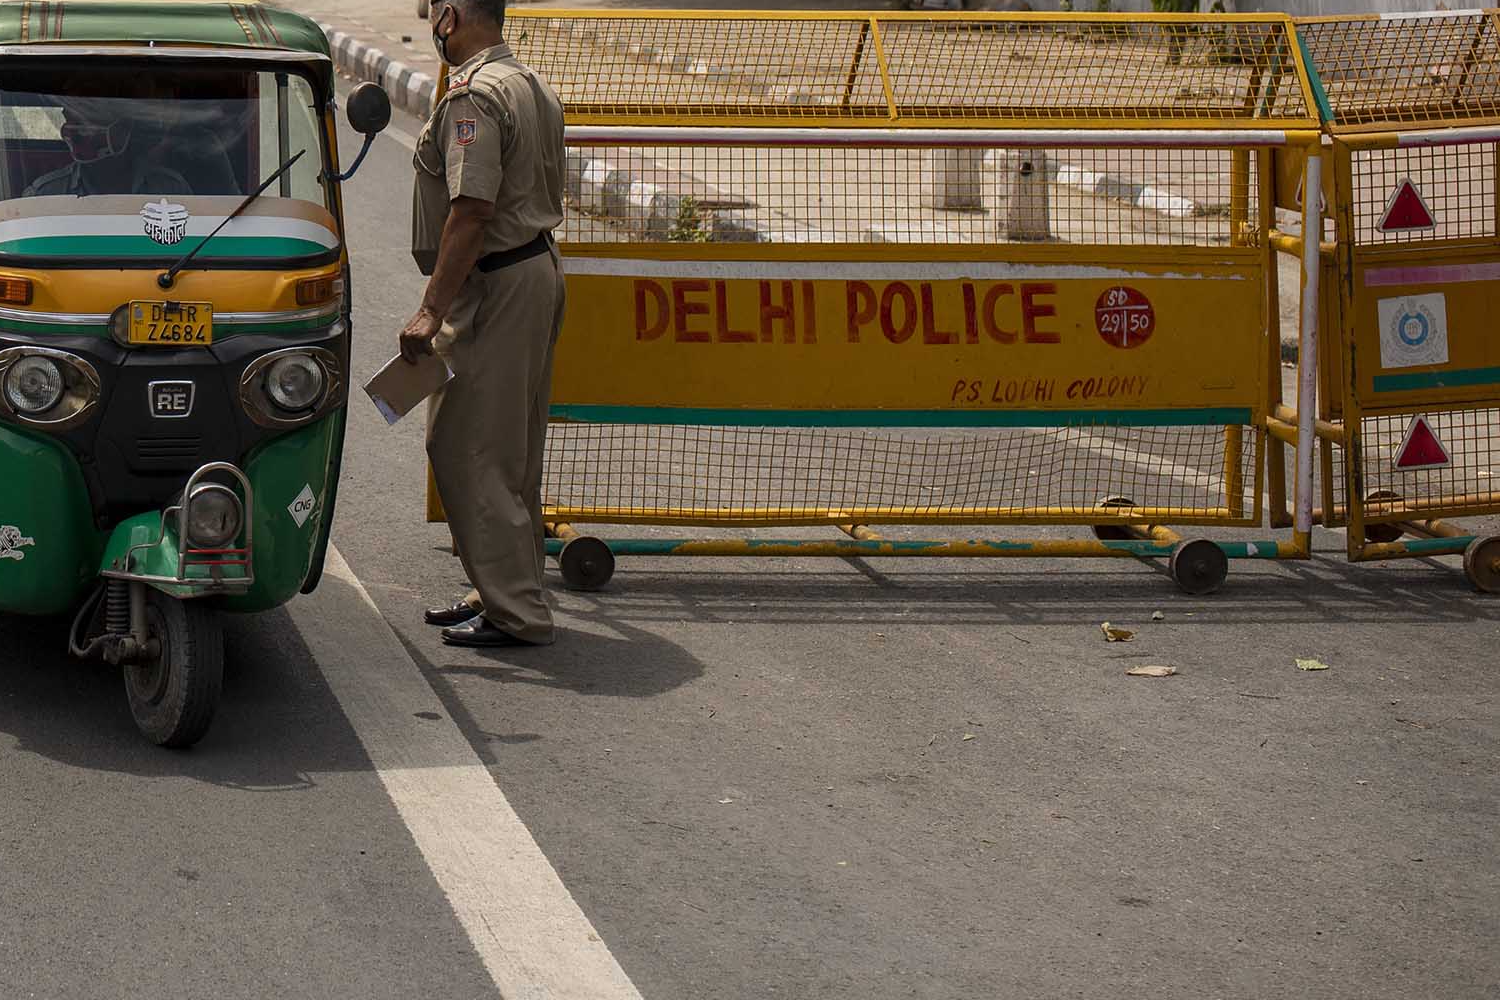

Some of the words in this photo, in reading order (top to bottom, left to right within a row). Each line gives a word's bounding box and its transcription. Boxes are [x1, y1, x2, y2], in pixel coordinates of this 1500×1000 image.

[633, 278, 818, 344] DELHI
[846, 279, 1061, 344] POLICE
[1130, 313, 1150, 331] 50
[147, 323, 205, 342] Z4684
[992, 378, 1055, 402] LODHI
[1066, 375, 1148, 401] COLONY
[157, 393, 186, 410] RE
[295, 499, 311, 512] CNG
